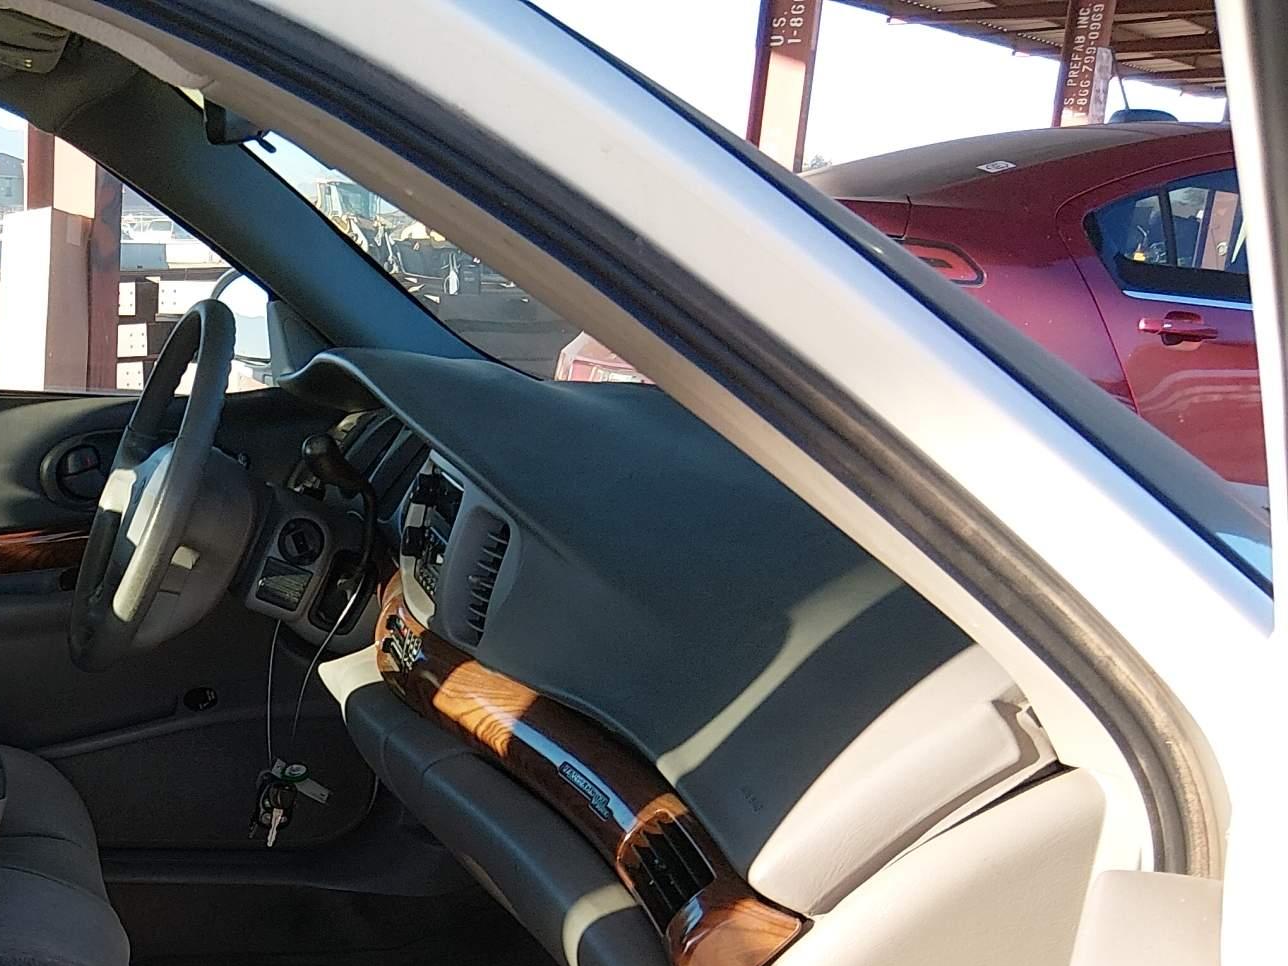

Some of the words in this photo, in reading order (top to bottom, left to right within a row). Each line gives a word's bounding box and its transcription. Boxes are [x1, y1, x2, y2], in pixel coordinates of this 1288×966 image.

[770, 11, 788, 47] U.S.
[787, 0, 805, 44] 1-86
[1067, 34, 1086, 87] PREFAB
[1077, 3, 1093, 29] INC.
[1073, 3, 1104, 116] 1-866-799-0969
